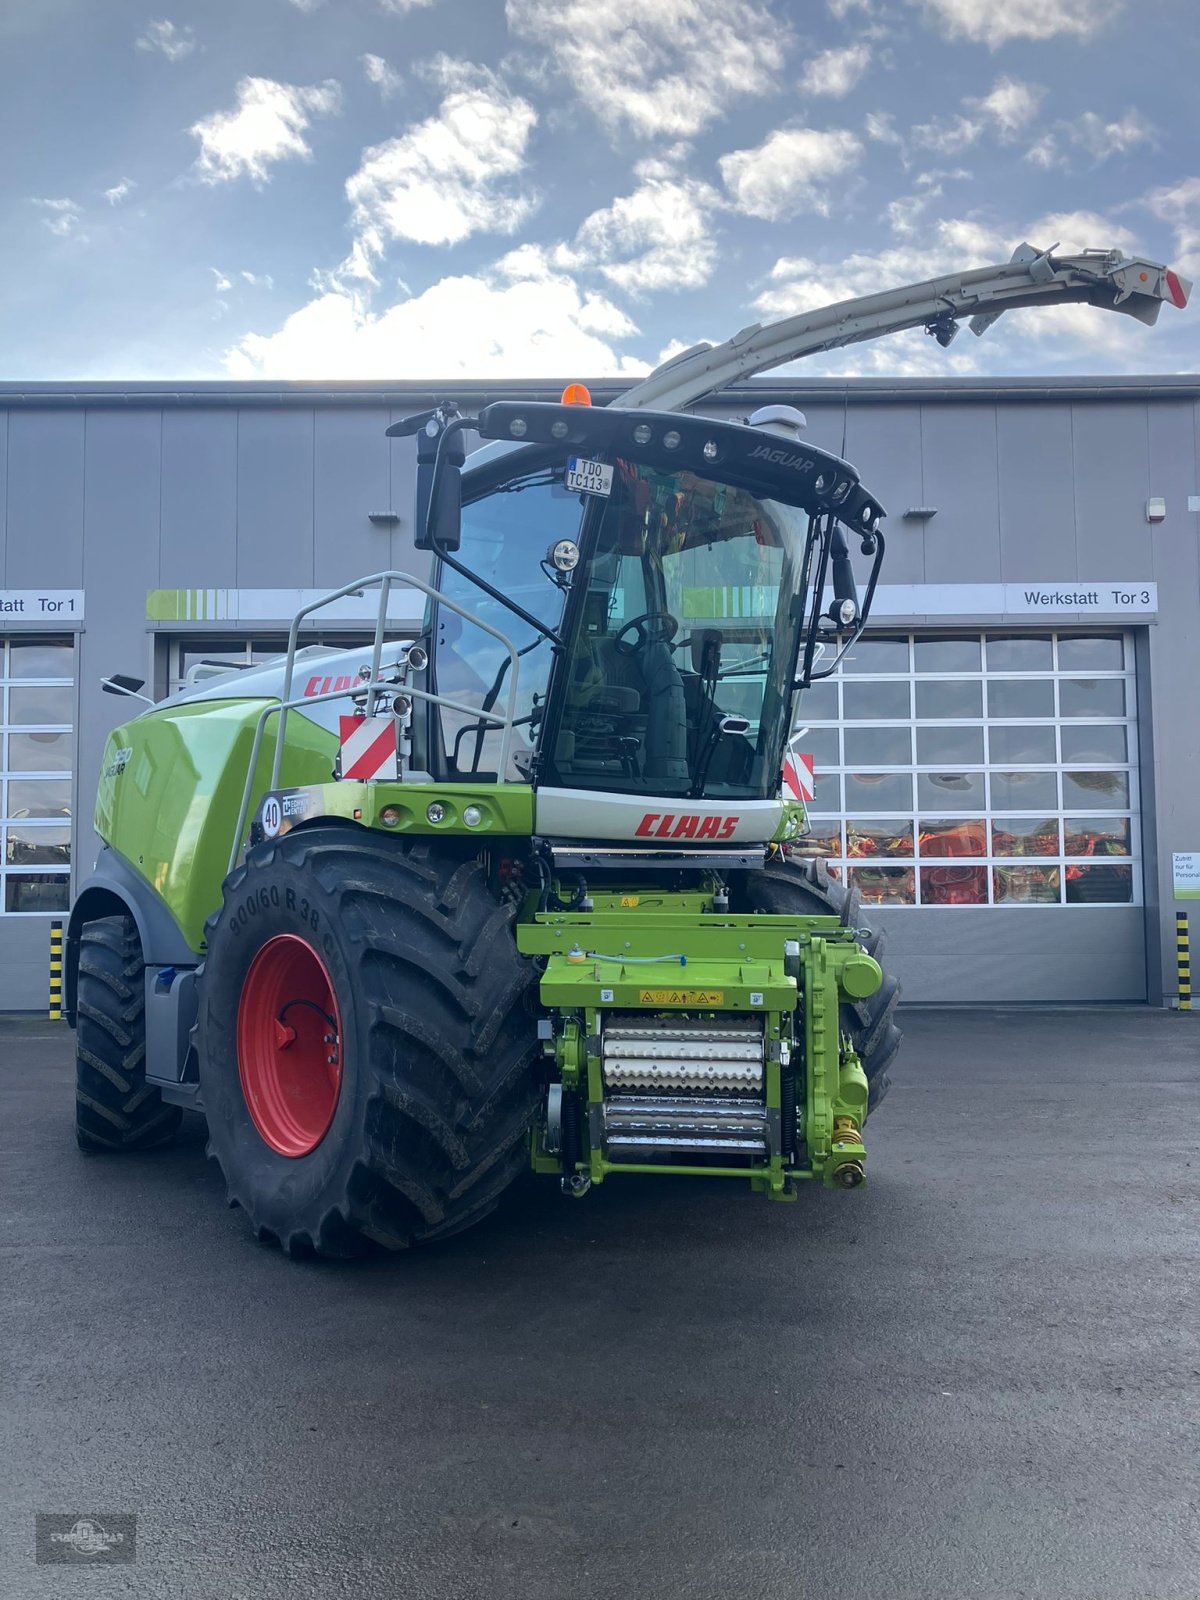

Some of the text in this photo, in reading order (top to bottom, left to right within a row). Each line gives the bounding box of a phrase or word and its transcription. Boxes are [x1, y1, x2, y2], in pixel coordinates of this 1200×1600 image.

[581, 460, 602, 477] TDO
[747, 445, 815, 473] JAGUAR
[569, 472, 603, 491] TC113
[38, 598, 64, 612] Tor
[68, 598, 75, 612] 1
[1024, 590, 1150, 605] Werkstatt Tor 3
[265, 803, 278, 829] 40
[635, 814, 739, 839] CLAAS
[230, 885, 280, 936] 900/60
[285, 887, 297, 912] R
[300, 898, 320, 933] 38
